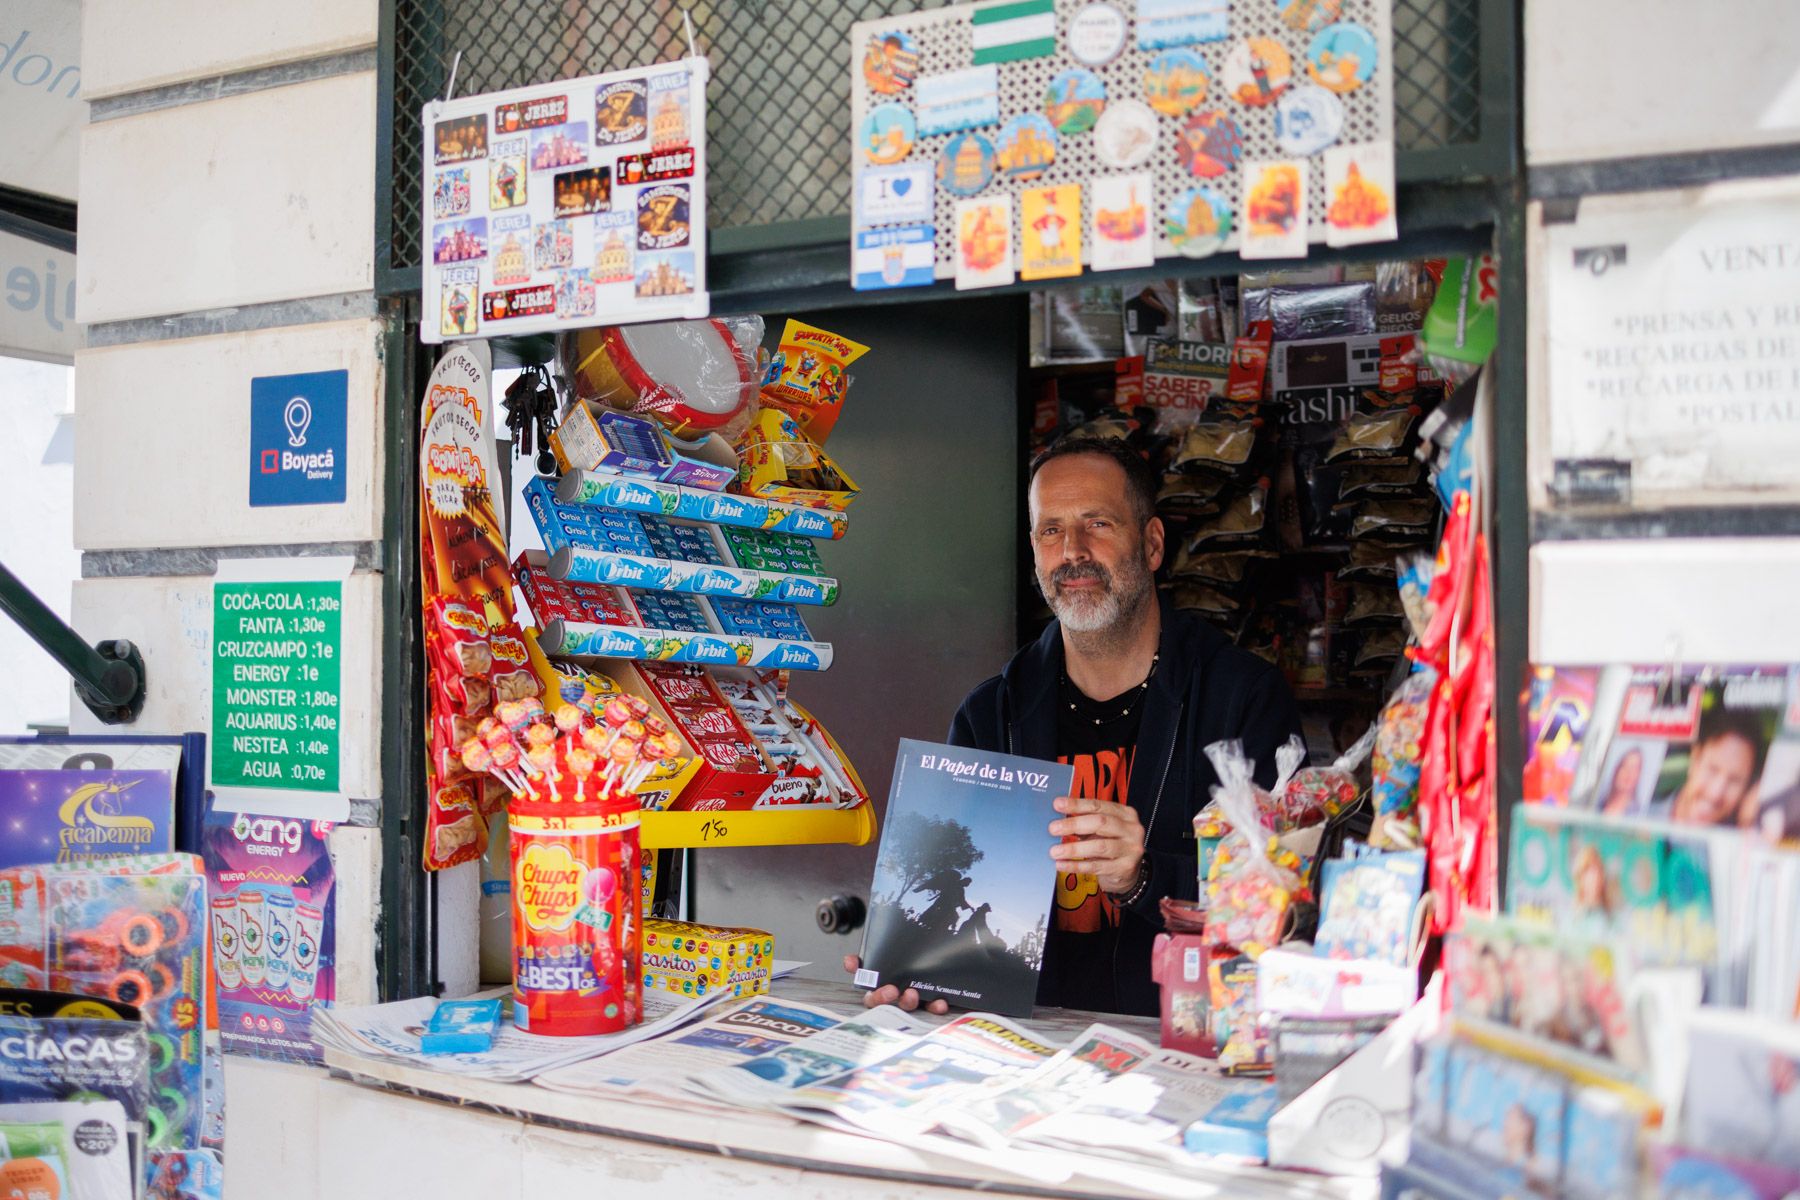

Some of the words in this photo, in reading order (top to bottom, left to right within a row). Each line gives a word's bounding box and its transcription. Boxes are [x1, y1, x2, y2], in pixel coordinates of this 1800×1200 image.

[524, 100, 565, 121] JEREZ
[491, 140, 524, 156] JEREZ
[647, 152, 692, 174] JEREZ
[443, 267, 476, 282] JEREZ
[512, 289, 553, 310] JEREZ
[1745, 307, 1763, 328] Y
[1757, 336, 1794, 359] DE
[1145, 376, 1213, 394] SABER
[1744, 368, 1782, 392] DE
[776, 384, 813, 402] WARRIORS
[431, 411, 455, 438] FRUTOS
[455, 412, 480, 442] SECOS
[282, 448, 334, 472] Boyacá
[307, 470, 333, 480] Delivery
[692, 468, 720, 480] Stitch
[437, 485, 456, 493] PARA
[609, 482, 653, 505] Orbit
[437, 496, 459, 505] PICAR
[704, 495, 744, 519] Orbit
[532, 495, 548, 528] Orbit
[558, 511, 582, 522] Orbit
[602, 518, 625, 529] Orbit
[789, 510, 826, 531] Orbit
[564, 525, 588, 536] Orbit
[608, 532, 631, 543] Orbit
[674, 527, 695, 537] Orbit
[571, 541, 595, 551] Orbit
[615, 546, 638, 556] Orbit
[680, 541, 702, 551] Orbit
[786, 546, 805, 556] Orbit
[686, 554, 708, 564] Orbit
[791, 560, 811, 570] Orbit
[600, 557, 644, 581] Orbit
[519, 568, 537, 601] Orbit
[695, 569, 735, 591] Orbit
[540, 585, 556, 594] rbit
[574, 586, 598, 597] Orbit
[781, 578, 817, 600] Orbit
[222, 593, 304, 611] COCA-COLA
[546, 598, 562, 606] rbit
[661, 598, 682, 607] Orbit
[763, 605, 783, 615] Orbit
[595, 609, 619, 620] Orbit
[668, 611, 689, 620] Orbit
[735, 617, 755, 626] Orbit
[239, 617, 285, 634] FANTA
[674, 624, 696, 633] Orbit
[772, 620, 792, 629] Orbit
[592, 630, 636, 653] Orbit
[741, 629, 761, 638] Orbit
[778, 631, 797, 640] Orbit
[218, 641, 307, 658] CRUZCAMPO
[689, 637, 728, 660] Orbit
[776, 645, 812, 665] Orbit
[233, 665, 290, 682] ENERGY
[226, 688, 296, 707] MONSTER
[661, 680, 693, 698] KitKat
[225, 712, 297, 731] AQUARIUS
[701, 711, 733, 733] KitKat
[233, 736, 289, 754] NESTEA
[710, 743, 740, 763] KitKat
[242, 761, 282, 778] AGUA
[920, 754, 935, 769] El
[937, 757, 979, 776] Papel
[979, 764, 997, 780] de
[999, 767, 1014, 783] la
[1016, 770, 1049, 789] VOZ
[772, 780, 803, 795] bueno
[952, 777, 976, 785] FEBRERO
[980, 781, 999, 789] MARZO
[59, 826, 151, 847] Academia
[232, 812, 302, 854] bang
[246, 844, 284, 857] ENERGY
[220, 872, 246, 882] NUEVO
[522, 863, 579, 889] Chupa
[521, 884, 577, 914] Chups
[242, 953, 265, 969] bang
[643, 952, 697, 973] casitos
[291, 966, 314, 986] bang
[529, 966, 584, 990] BEST
[581, 978, 597, 989] OF
[727, 967, 768, 985] Lacasitos
[910, 980, 934, 991] Edición
[935, 985, 961, 996] Semana
[961, 990, 982, 999] Santa
